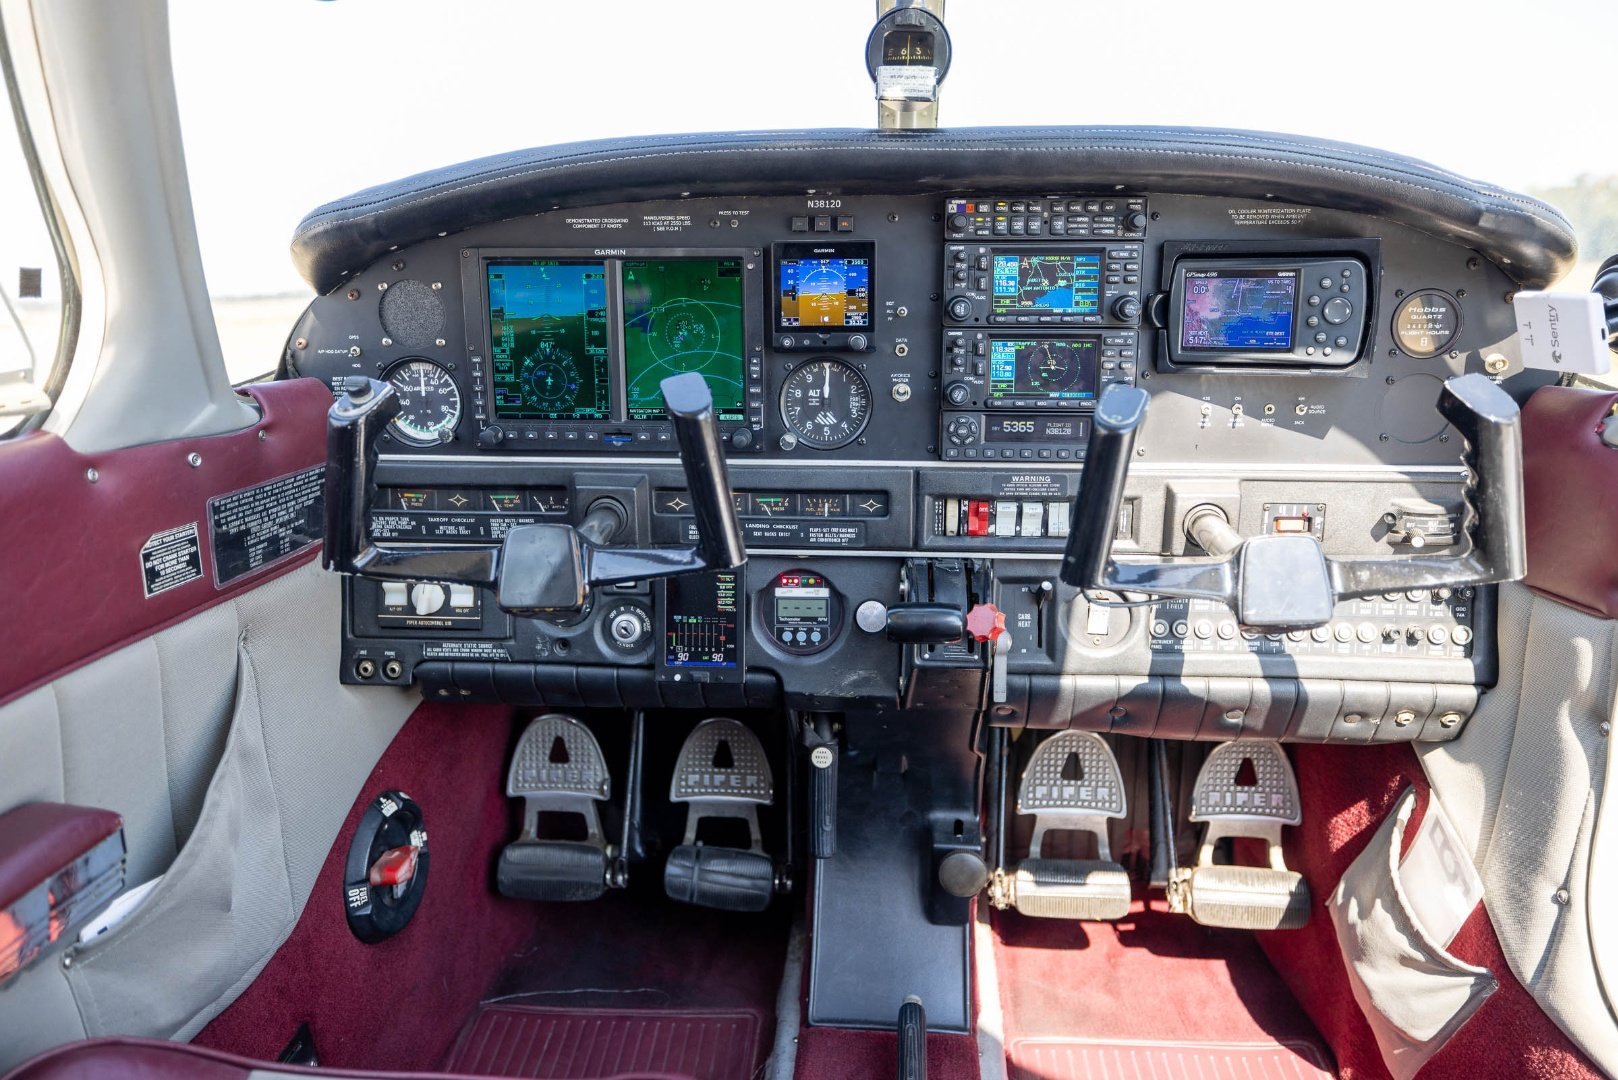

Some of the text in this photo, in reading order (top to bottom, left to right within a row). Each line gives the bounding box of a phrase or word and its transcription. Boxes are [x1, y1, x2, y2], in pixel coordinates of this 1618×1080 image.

[901, 47, 922, 55] 6 3
[807, 200, 841, 208] N38120
[1547, 304, 1560, 348] Sentry
[806, 374, 813, 383] 9
[795, 390, 801, 398] 8
[808, 389, 820, 397] ALT
[851, 385, 857, 394] 2
[794, 407, 800, 415] 7
[851, 410, 857, 418] 3
[806, 422, 813, 430] 6
[1003, 421, 1035, 433] 5365
[824, 427, 830, 435] 5
[163, 535, 175, 543] YOUR
[145, 561, 153, 569] DO
[152, 558, 163, 566] NOT
[162, 552, 178, 562] CRANK
[178, 546, 197, 556] STARTER
[165, 559, 178, 567] MORE
[178, 555, 190, 563] THAN
[677, 652, 689, 661] 90
[712, 653, 724, 662] 90
[523, 769, 593, 782] PIPER
[687, 774, 759, 787] PIPER
[1035, 785, 1110, 800] PIPER
[1208, 791, 1285, 806] PIPER
[348, 888, 361, 908] OFF
[359, 887, 368, 905] FUEL
